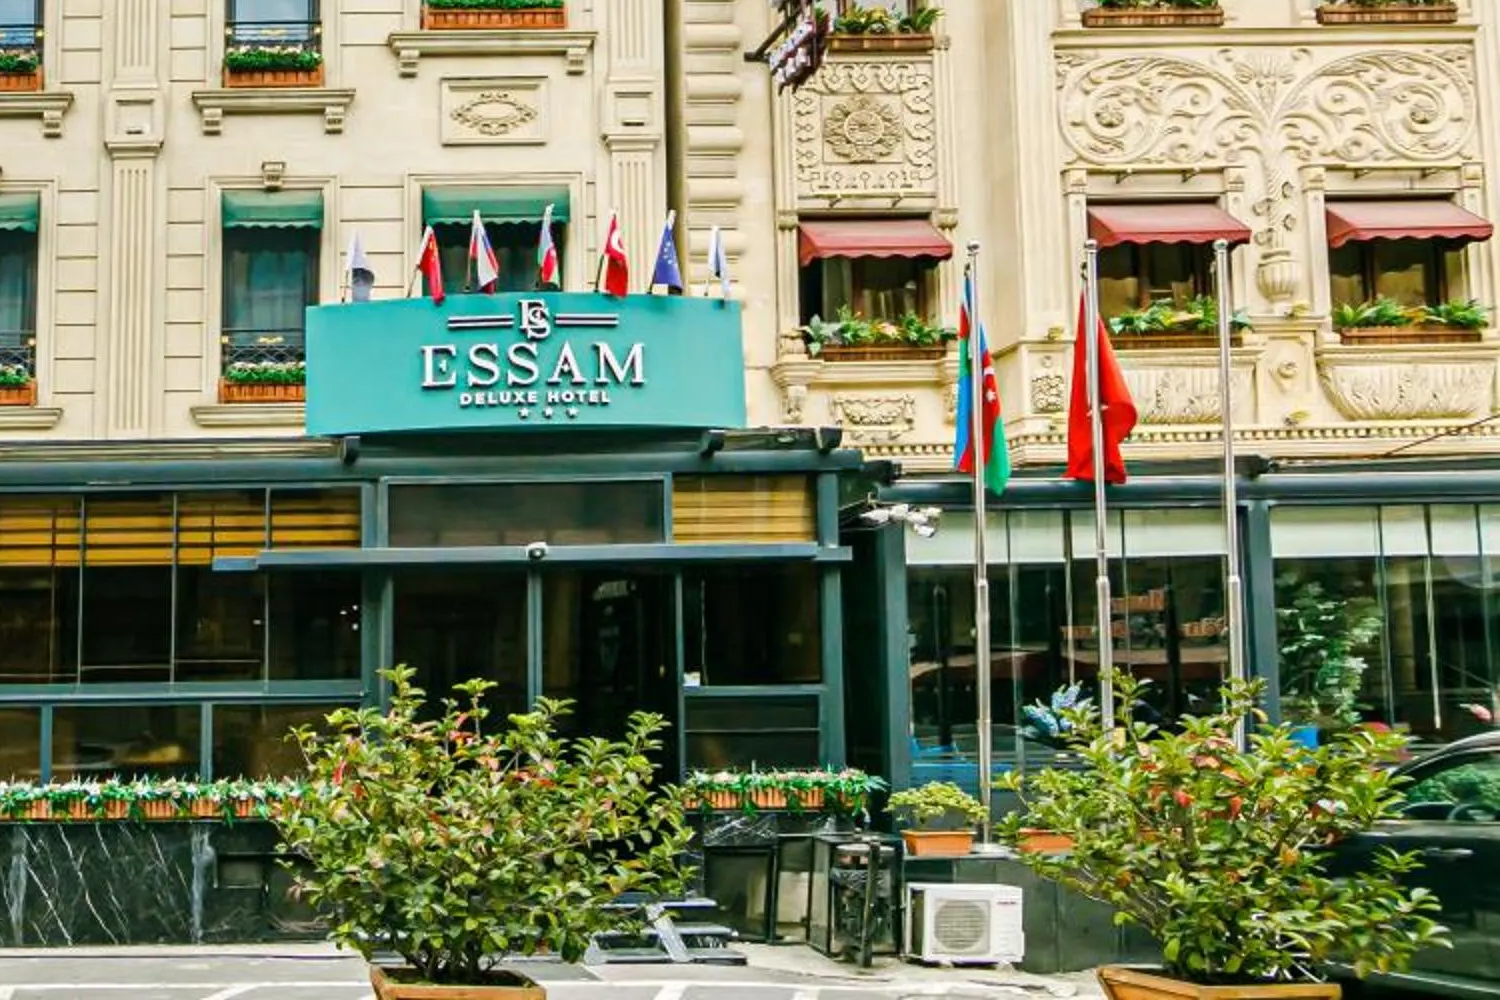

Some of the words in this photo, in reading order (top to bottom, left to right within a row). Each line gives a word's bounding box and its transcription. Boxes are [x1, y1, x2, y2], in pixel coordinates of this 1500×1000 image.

[420, 340, 646, 389] ESSAM
[459, 390, 538, 407] DELUXE
[548, 389, 611, 405] HOTEL
